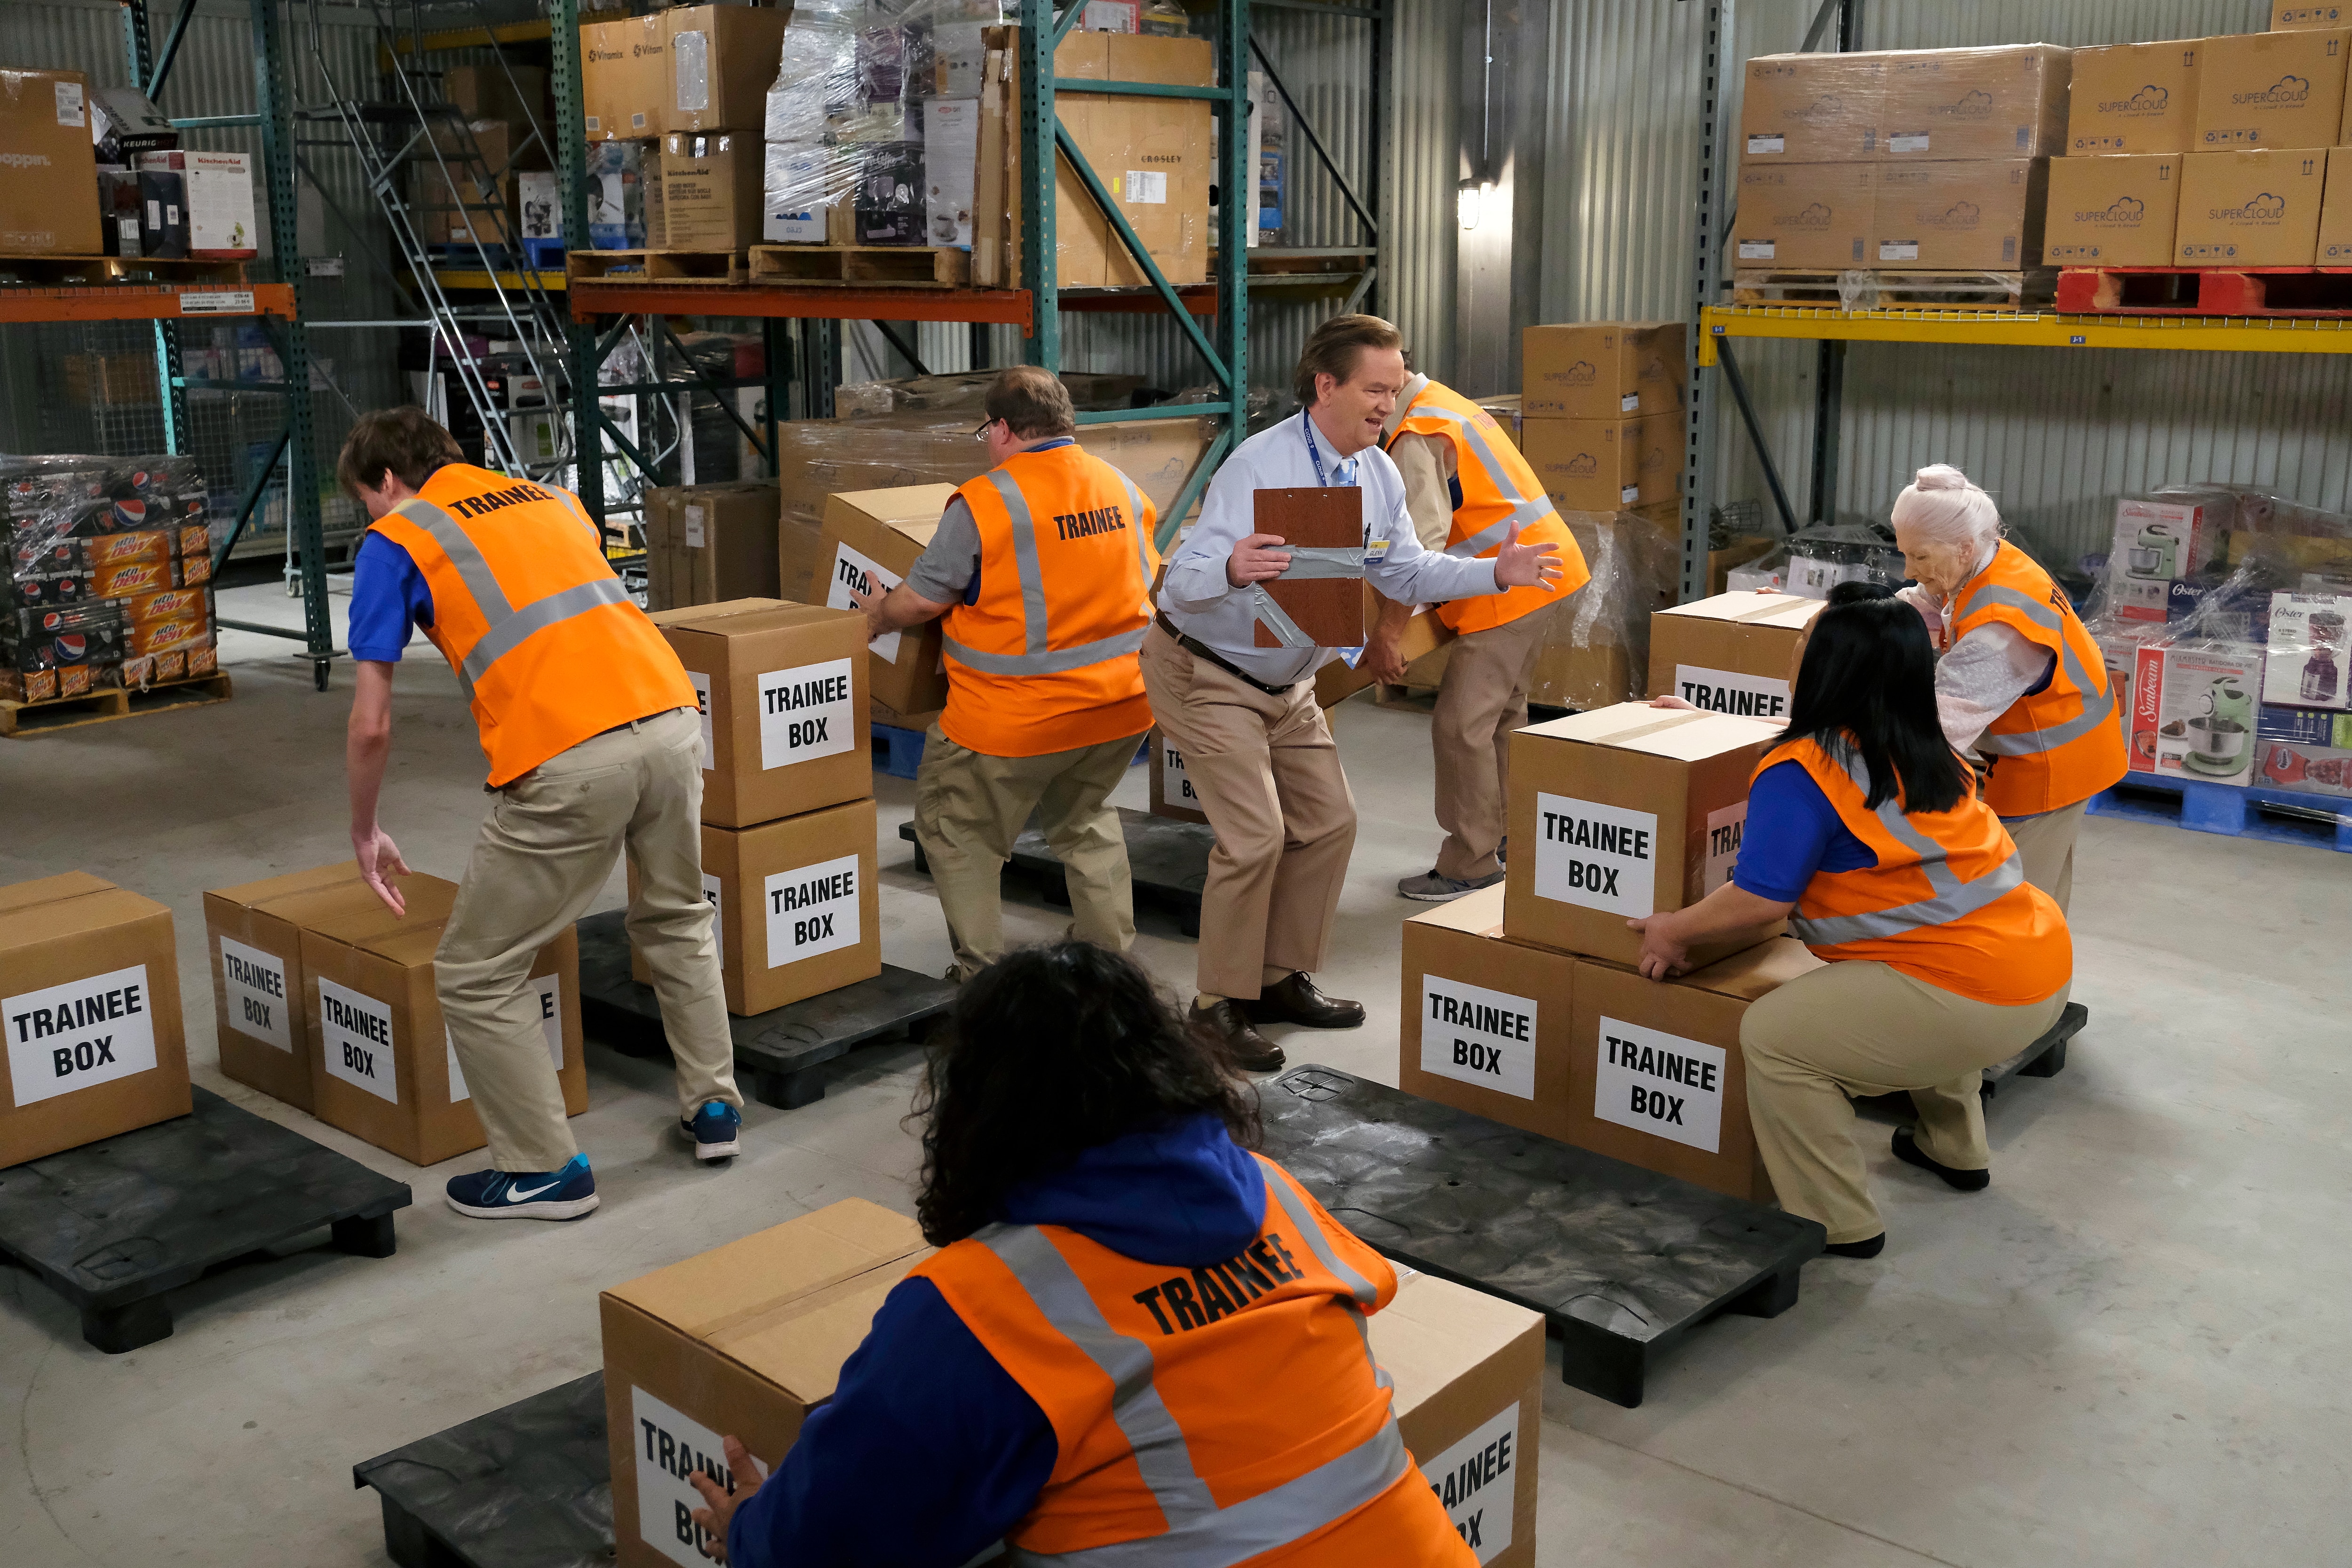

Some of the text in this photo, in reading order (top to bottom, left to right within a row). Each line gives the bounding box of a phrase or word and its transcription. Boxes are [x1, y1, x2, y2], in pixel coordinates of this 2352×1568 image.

[597, 51, 623, 61] Vitamix
[2098, 100, 2168, 112] SUPERCLOUD
[2232, 91, 2308, 104] SUPERCLOUD
[1773, 216, 1832, 225] SUPERCLOUD
[2074, 211, 2144, 222] SUPERCLOUD
[2209, 208, 2284, 219] SUPERCLOUD
[1544, 372, 1596, 382] SUPERCLOUD
[447, 484, 555, 519] TRAINEE
[1053, 505, 1126, 541] TRAINEE
[2172, 583, 2203, 596] Oster
[2275, 607, 2304, 618] Oster
[764, 675, 848, 715] TRAINEE
[2139, 660, 2158, 723] Sunbeam
[789, 717, 828, 749] BOX
[1543, 812, 1649, 860] TRAINEE
[771, 871, 854, 915] TRAINEE
[1568, 859, 1619, 897] BOX
[795, 912, 834, 946] BOX
[225, 953, 283, 998] TRAINEE
[13, 984, 142, 1043] TRAINEE
[243, 996, 272, 1030] BOX
[324, 995, 389, 1047] TRAINEE
[1429, 992, 1529, 1042] TRAINEE
[53, 1035, 115, 1077] BOX
[343, 1041, 375, 1079] BOX
[1453, 1038, 1502, 1075] BOX
[1605, 1035, 1716, 1092] TRAINEE
[1630, 1084, 1685, 1126] BOX
[1133, 1233, 1305, 1336] TRAINEE
